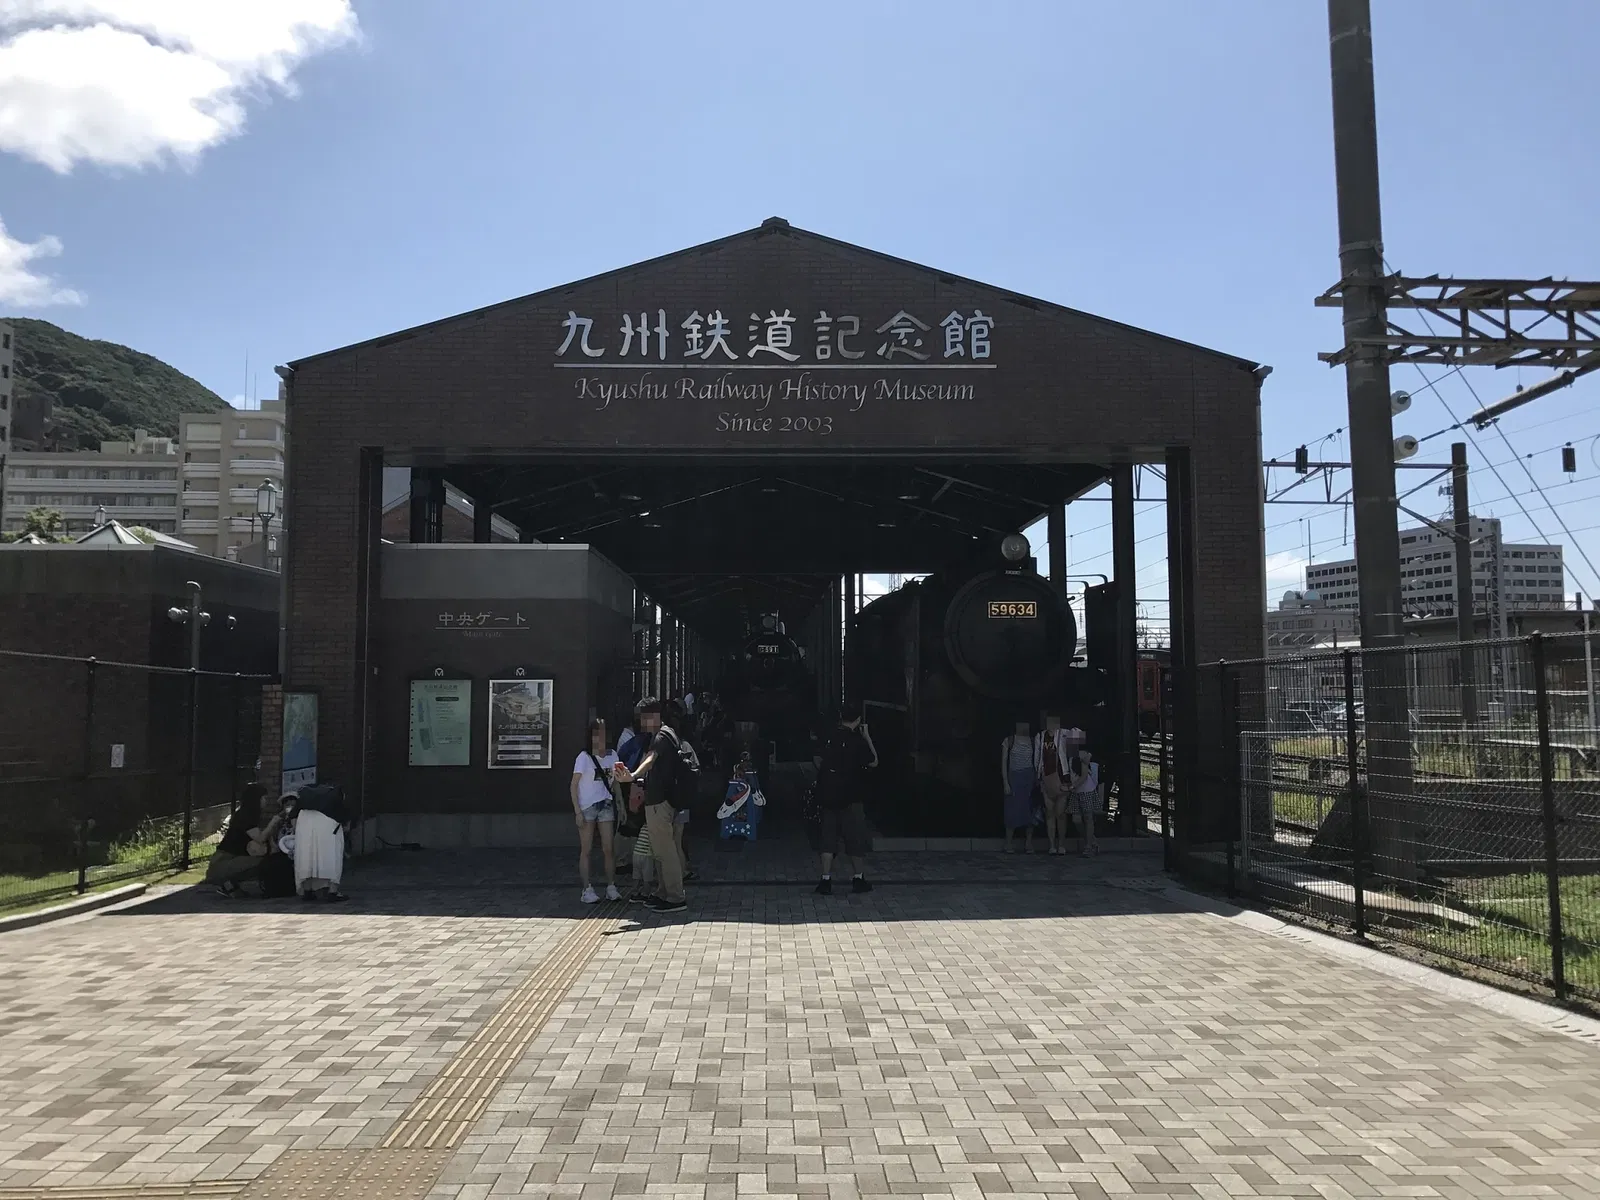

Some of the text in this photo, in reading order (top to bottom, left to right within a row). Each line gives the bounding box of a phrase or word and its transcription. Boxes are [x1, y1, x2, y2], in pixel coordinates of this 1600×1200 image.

[554, 308, 996, 362] 九州鉄道記念館
[574, 372, 976, 412] Kyushu Railway History Museum
[716, 412, 834, 435] Since 2003
[438, 611, 527, 627] 中央ゲート
[990, 603, 1034, 616] 59634
